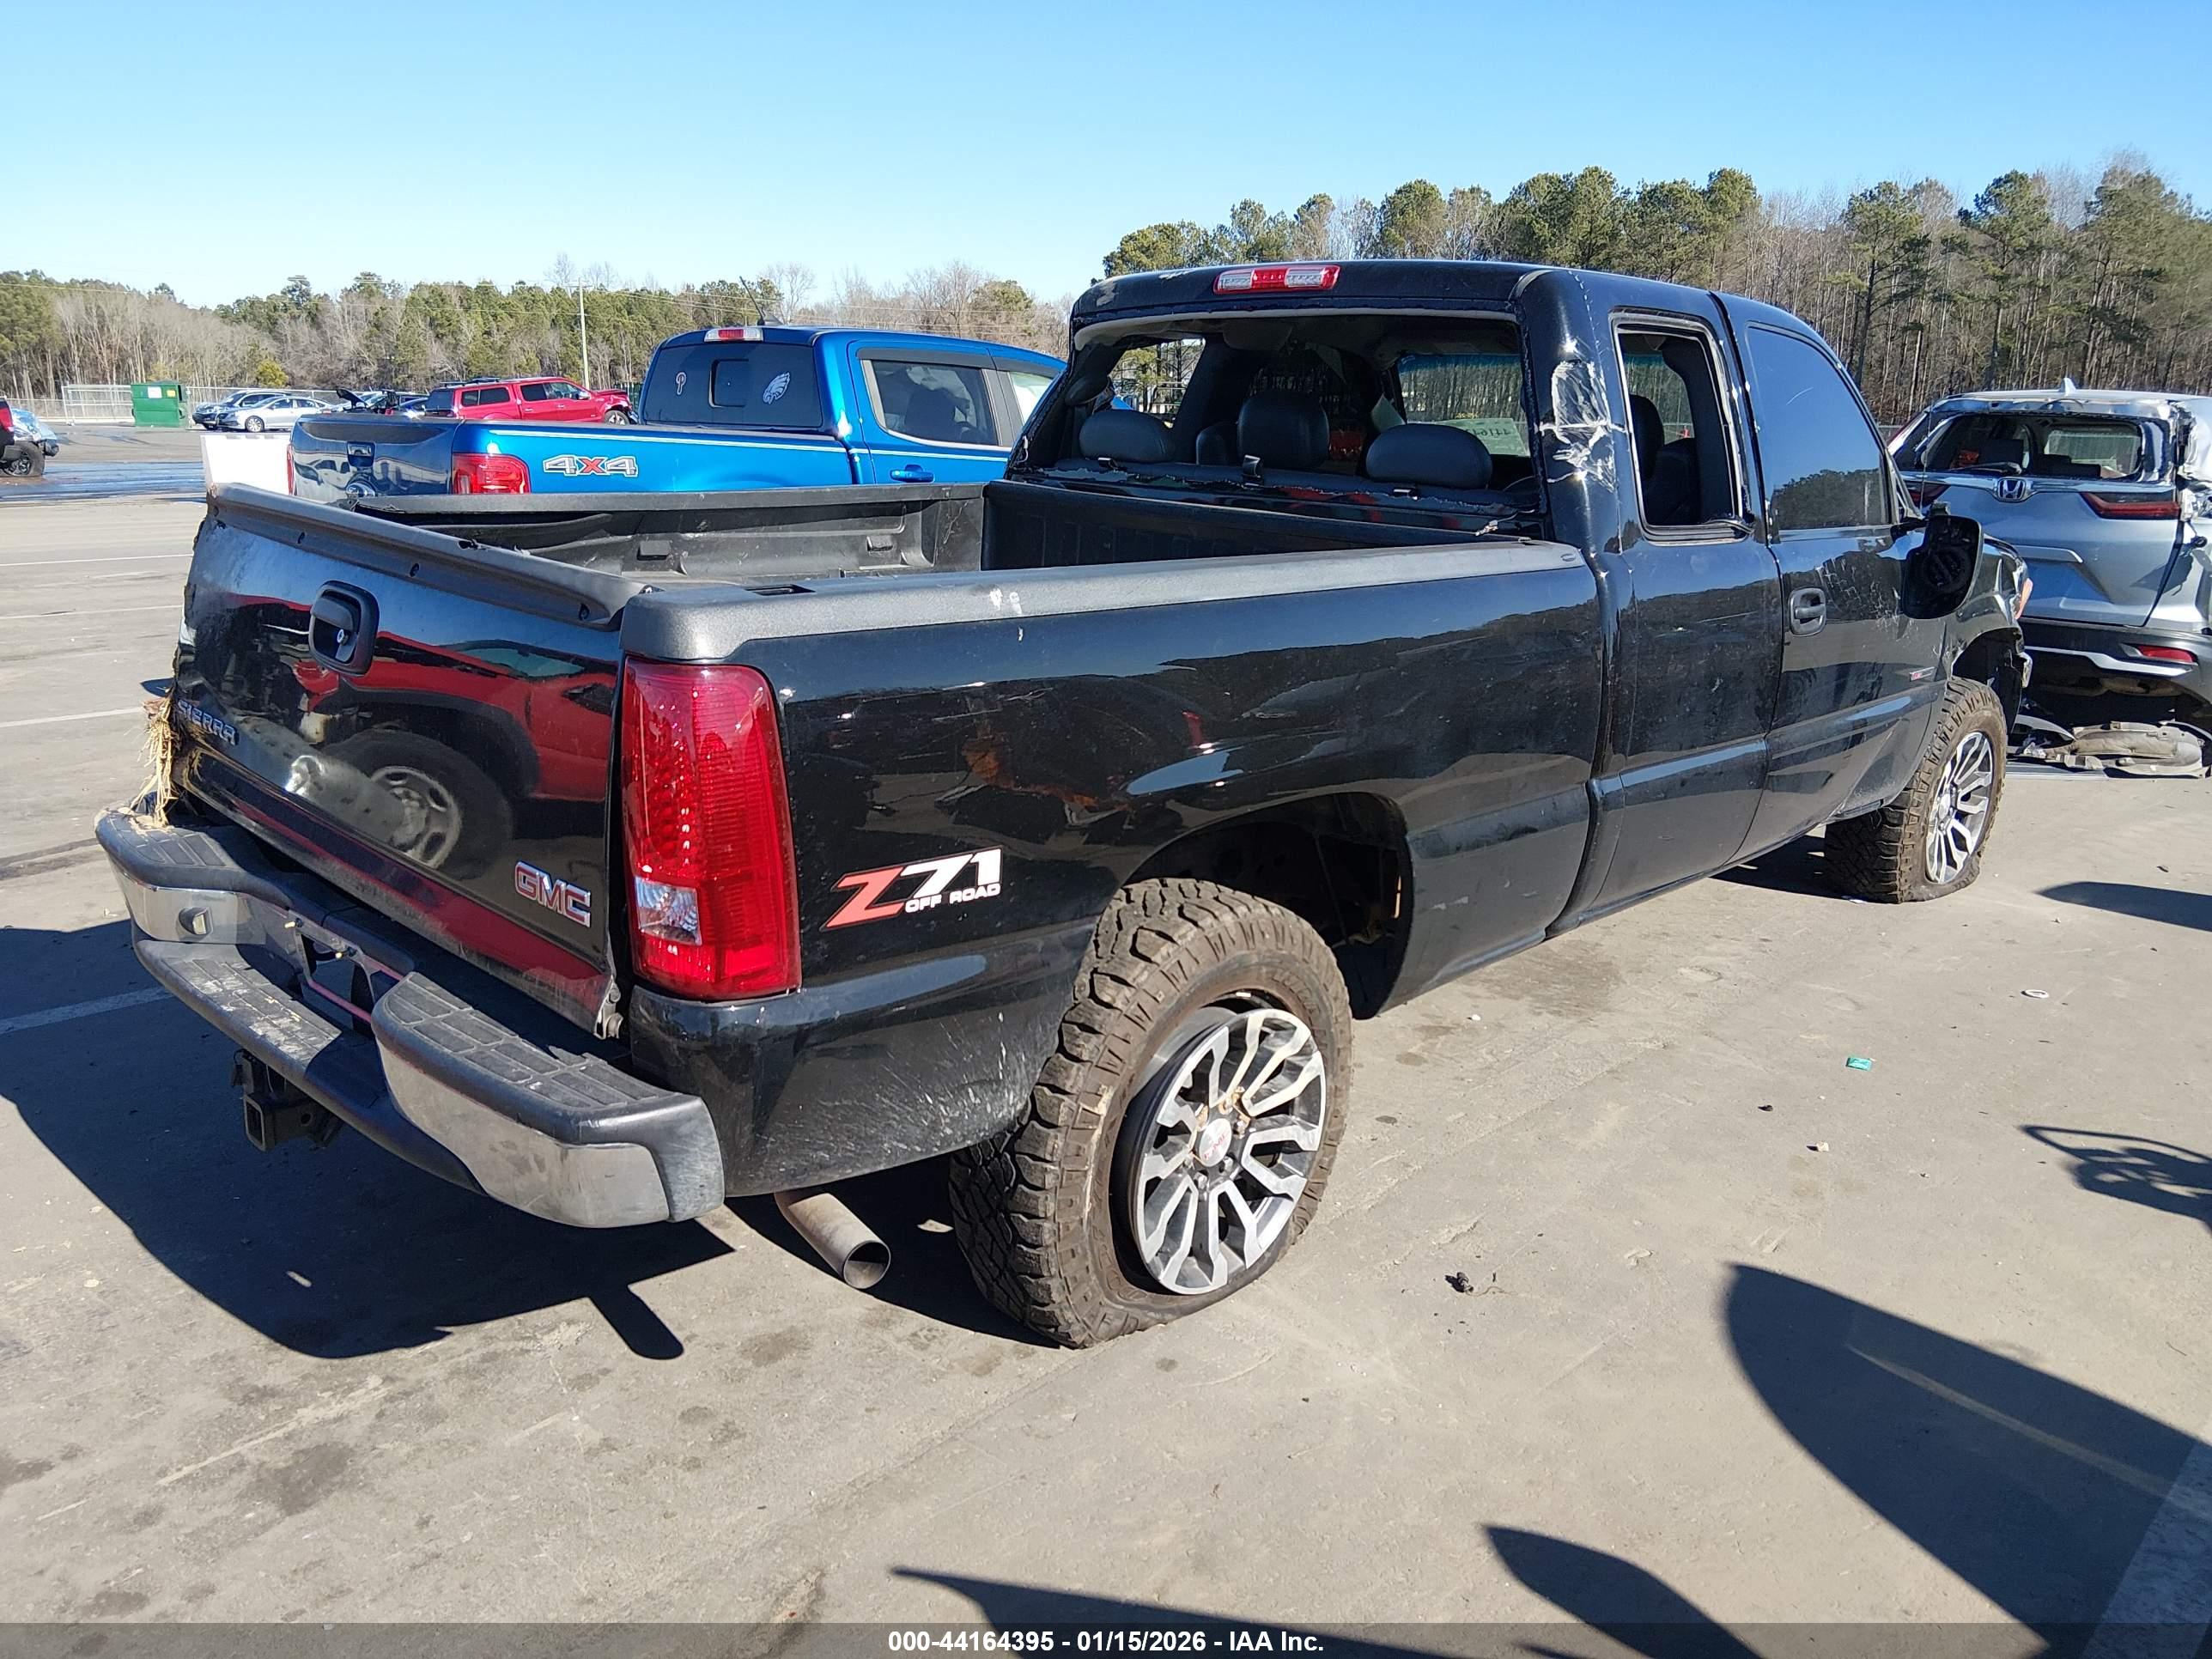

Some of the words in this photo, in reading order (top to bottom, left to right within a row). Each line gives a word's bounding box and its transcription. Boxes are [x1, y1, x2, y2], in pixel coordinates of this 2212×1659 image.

[177, 699, 237, 746] SIERRA
[514, 860, 592, 928] GMC
[822, 847, 1001, 929] Z71
[904, 894, 943, 914] OFF
[949, 883, 1001, 904] ROAD
